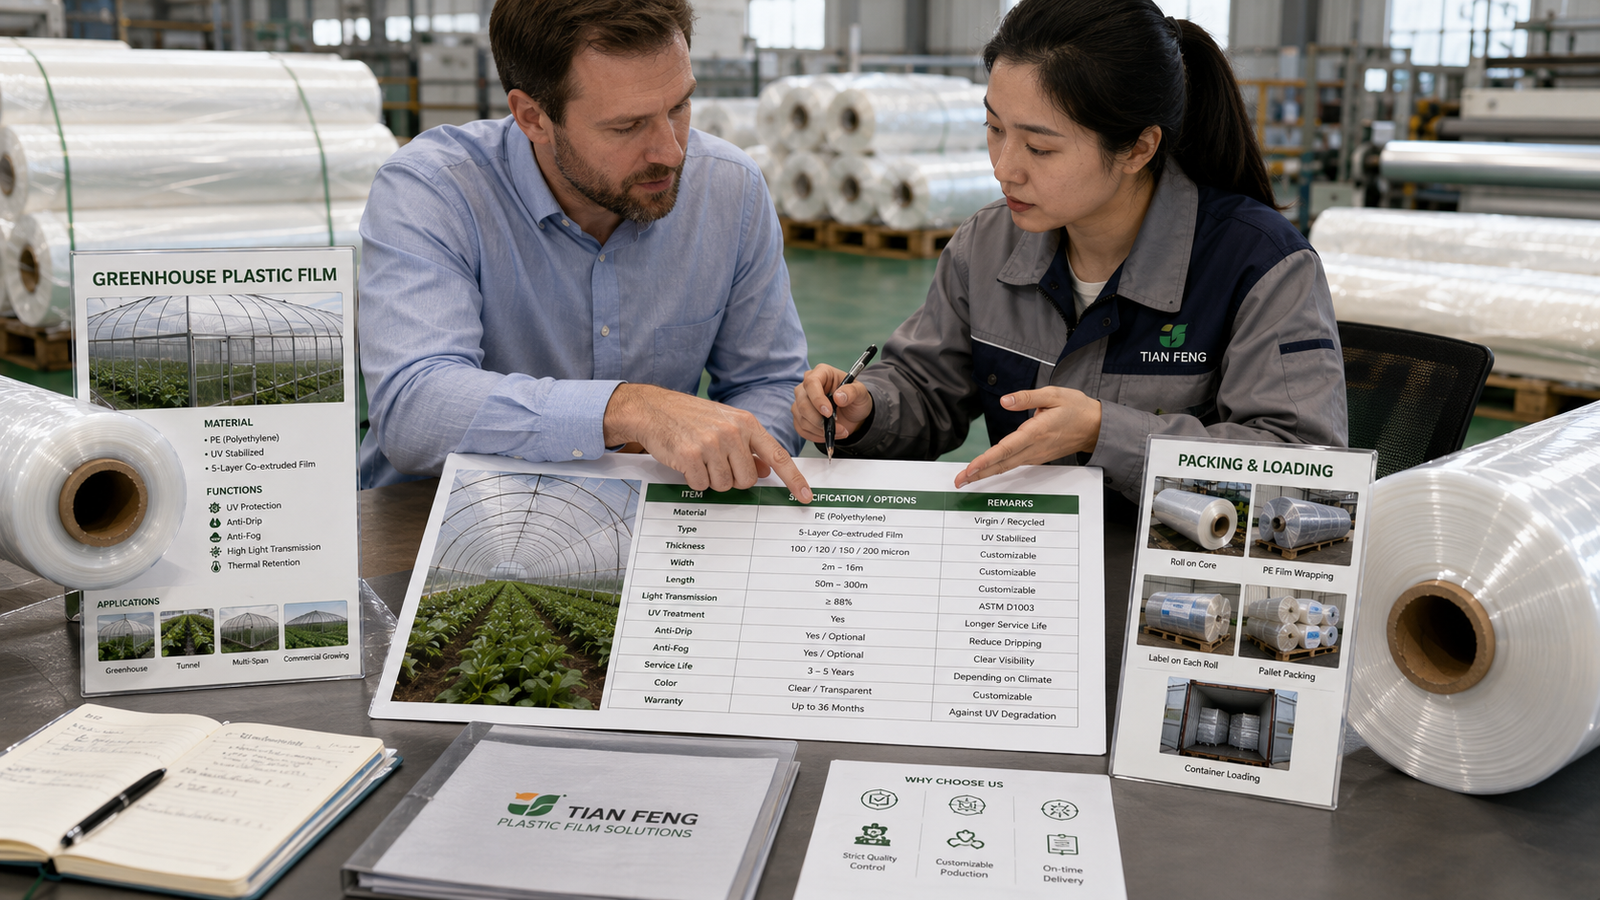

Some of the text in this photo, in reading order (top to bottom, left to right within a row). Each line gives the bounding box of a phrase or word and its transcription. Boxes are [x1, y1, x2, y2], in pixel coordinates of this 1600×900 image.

[93, 268, 336, 286] GREENHOUSE PLASTIC FILM
[1140, 352, 1206, 362] TIAN FENG
[205, 419, 253, 427] MATERIAL
[223, 434, 279, 444] (Polyethylene)
[211, 448, 264, 458] UV Stabilized
[212, 465, 242, 473] 5-Layer
[245, 461, 297, 471] Co-extruded
[1179, 454, 1333, 477] PACKING & LOADING
[207, 486, 262, 495] FUNCTIONS
[682, 490, 703, 498] ITEM
[788, 493, 864, 502] SCIFICATION
[874, 496, 916, 504] OPTIONS
[988, 499, 1033, 507] REMARKS
[241, 502, 281, 510] Protection
[227, 517, 262, 526] Anti-Drip
[828, 513, 886, 522] (Polyethylene)
[975, 517, 998, 526] Virgin
[1008, 518, 1044, 527] Recycled
[678, 525, 697, 534] Type
[799, 529, 829, 538] 5-Layer
[832, 530, 883, 538] Co-extruded
[227, 532, 261, 541] Anti-Fog
[228, 544, 321, 556] High Light Transmission
[980, 551, 1036, 559] Customizable
[228, 559, 300, 569] Thermal Retention
[1171, 558, 1185, 567] Roll
[1199, 560, 1216, 569] Core
[979, 568, 1036, 576] Customizable
[1263, 566, 1333, 582] PE Film Wrapping
[666, 576, 694, 585] Length
[979, 585, 1035, 594] Customizable
[642, 592, 717, 601] Light Transmission
[97, 598, 159, 608] APPLICATIONS
[663, 610, 704, 618] Treatment
[965, 620, 1047, 630] Longer Service Life
[655, 627, 692, 636] Anti-Drip
[829, 633, 865, 642] Optional
[653, 644, 689, 654] Anti-Fog
[1005, 639, 1041, 649] Dripping
[284, 652, 349, 662] Commercial Growing
[827, 650, 863, 659] Optional
[177, 661, 200, 669] Tunnel
[645, 661, 693, 670] Service Life
[974, 655, 1034, 666] Clear Visibility
[1149, 654, 1169, 663] Label
[1183, 658, 1201, 667] Each
[1204, 660, 1218, 669] Roll
[106, 666, 148, 674] Greenhouse
[831, 668, 854, 676] Years
[1259, 667, 1315, 682] Pallet Packing
[954, 673, 1001, 683] Depending
[1018, 675, 1052, 683] Climate
[788, 684, 811, 692] Clear
[820, 686, 871, 695] Transparent
[645, 696, 683, 706] Warranty
[973, 691, 1032, 701] Customizable
[792, 703, 804, 711] Up
[832, 704, 864, 712] Months
[949, 708, 982, 717] Against
[1002, 710, 1056, 720] Degradation
[1185, 765, 1260, 784] Container Loading
[936, 778, 984, 787] CHOOSE
[569, 806, 698, 825] TIAN FENG
[497, 818, 692, 838] PLASTIC FILM SOLUTIONS
[843, 852, 897, 865] Strict Quality
[936, 858, 993, 869] Customizable
[850, 862, 885, 871] Control
[1043, 865, 1083, 874] On-time
[1043, 875, 1084, 886] Delivery
